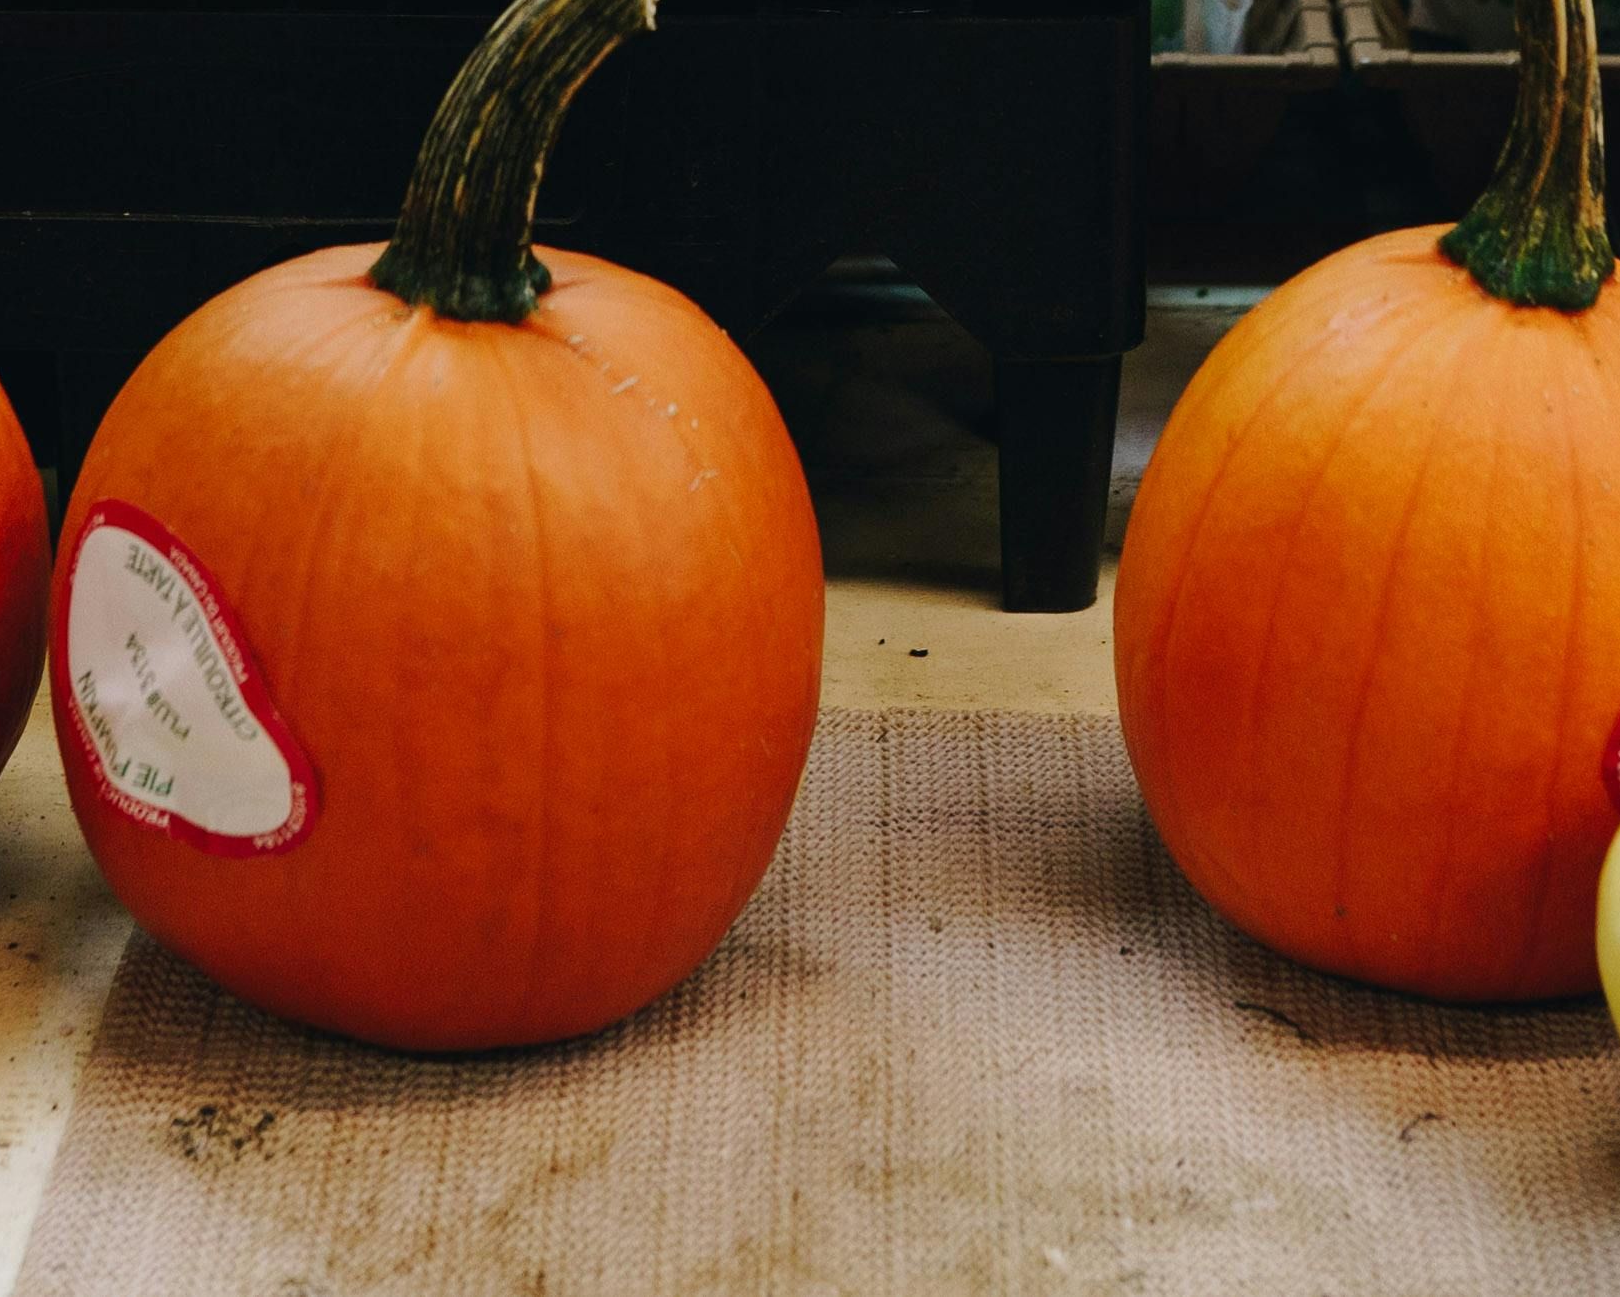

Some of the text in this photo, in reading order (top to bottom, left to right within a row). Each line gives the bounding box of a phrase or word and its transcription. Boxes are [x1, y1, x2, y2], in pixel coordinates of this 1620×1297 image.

[124, 543, 178, 601] TARTE
[78, 669, 175, 798] PIE PUMPKIN
[182, 614, 258, 742] CITROUILLE
